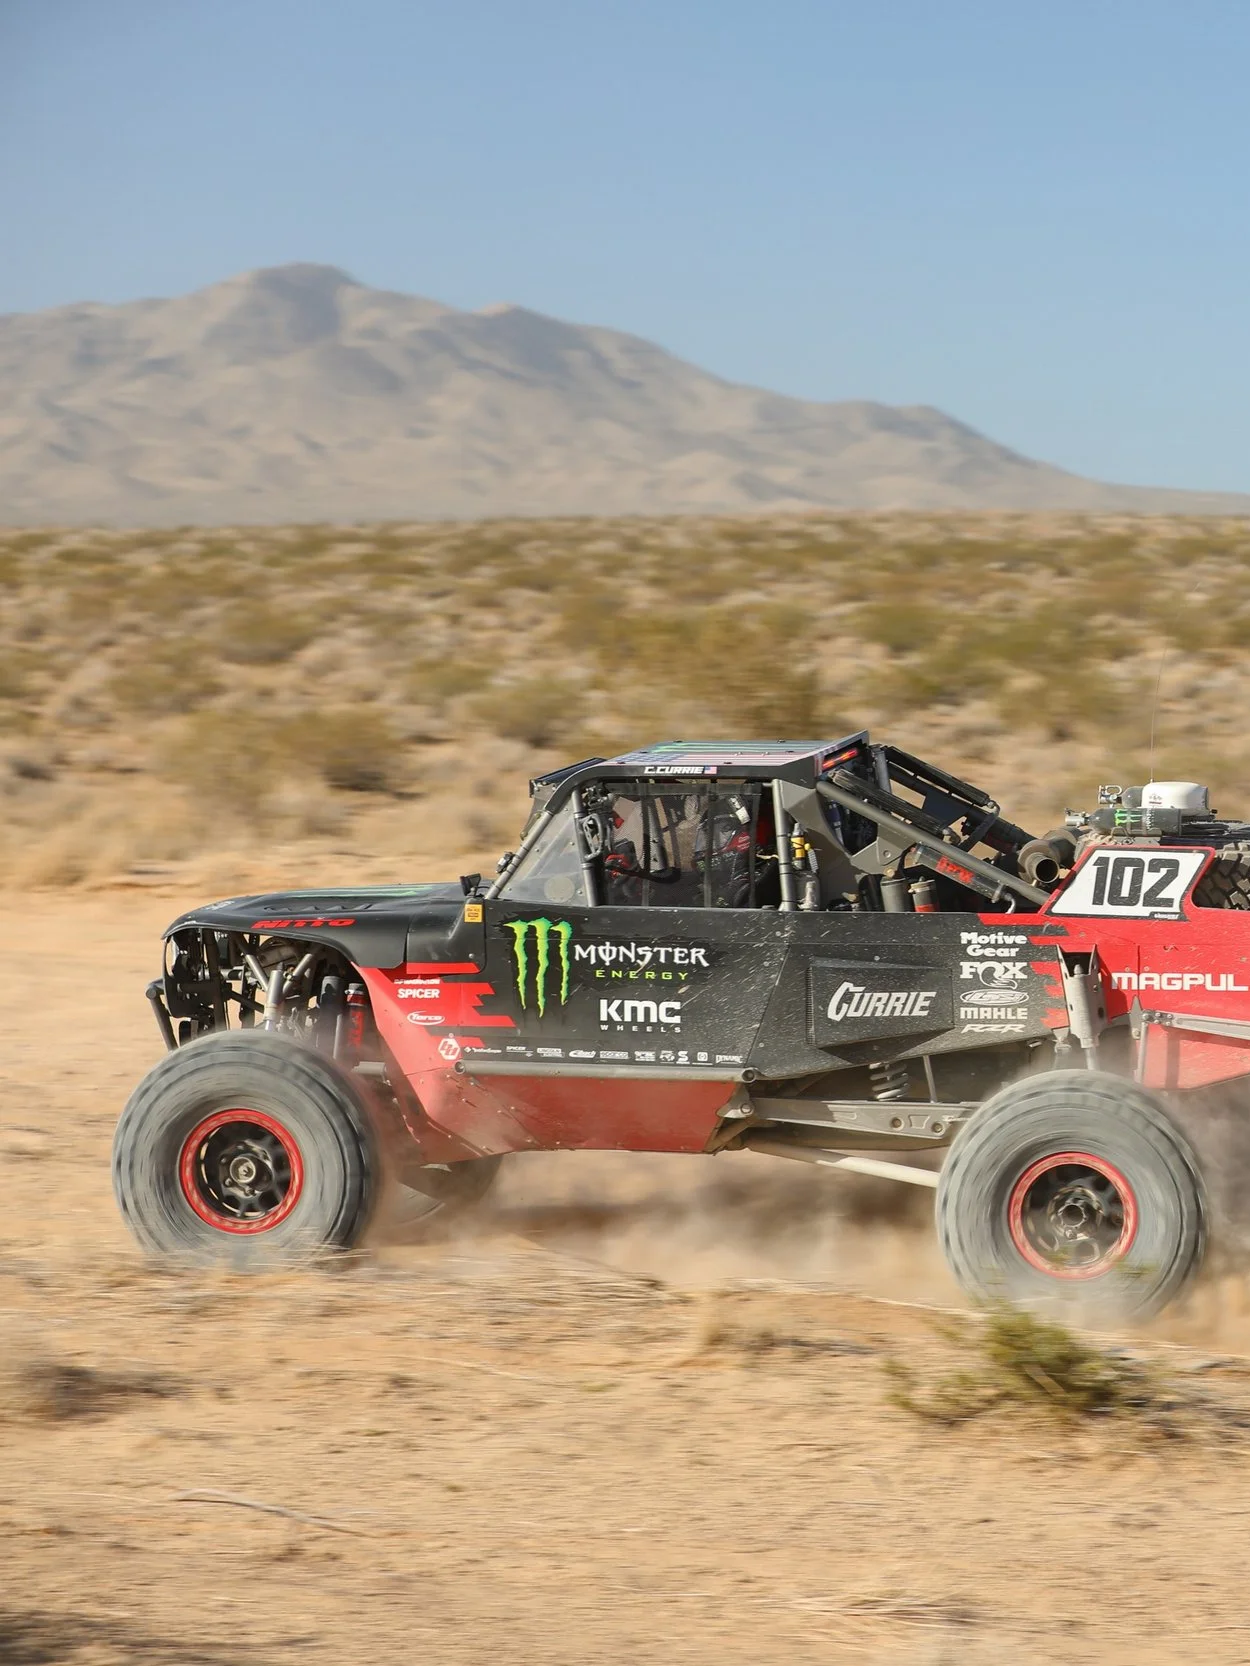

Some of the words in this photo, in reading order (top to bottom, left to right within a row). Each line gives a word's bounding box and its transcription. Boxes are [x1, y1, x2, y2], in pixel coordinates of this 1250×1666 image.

[643, 766, 704, 774] C.CURRIE
[1091, 856, 1180, 908] 102
[251, 918, 356, 929] NITTO
[959, 931, 1028, 945] Motive
[573, 941, 710, 967] MONSTER
[966, 944, 1020, 957] Gear
[595, 969, 689, 980] ENERGY
[1111, 972, 1249, 991] MAGPUL
[397, 988, 440, 999] SPICER
[827, 981, 937, 1022] CURRIE
[960, 1007, 1028, 1020] MAHLE
[600, 1024, 681, 1033] WHEELS
